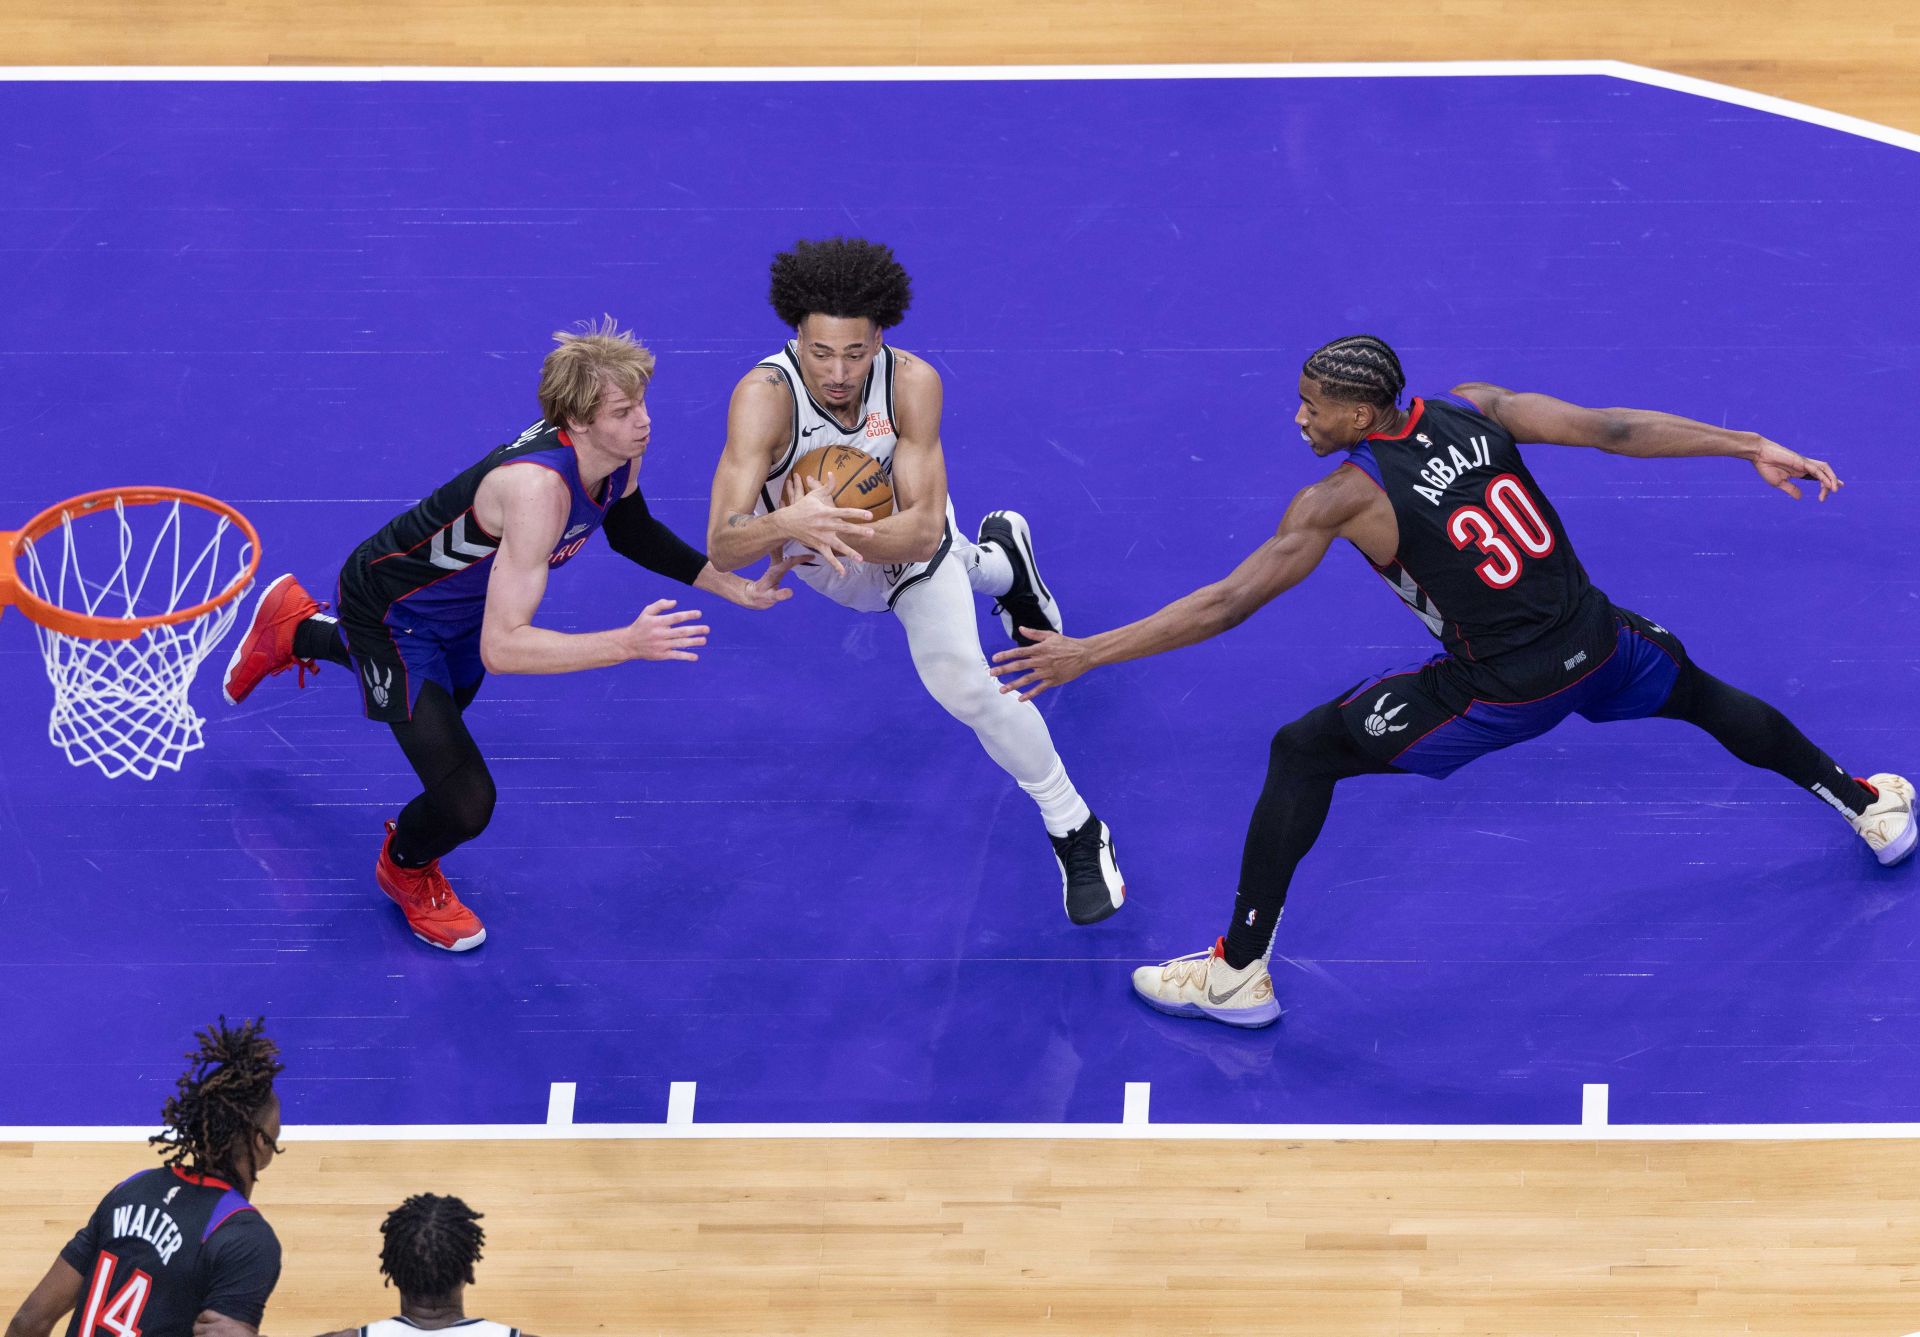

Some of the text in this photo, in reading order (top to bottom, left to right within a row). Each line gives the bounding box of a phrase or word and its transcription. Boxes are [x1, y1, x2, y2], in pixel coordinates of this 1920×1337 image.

[1412, 435, 1491, 506] AGBAJI
[1447, 473, 1555, 590] 30
[113, 1204, 183, 1266] WALTER
[77, 1249, 153, 1337] 14
